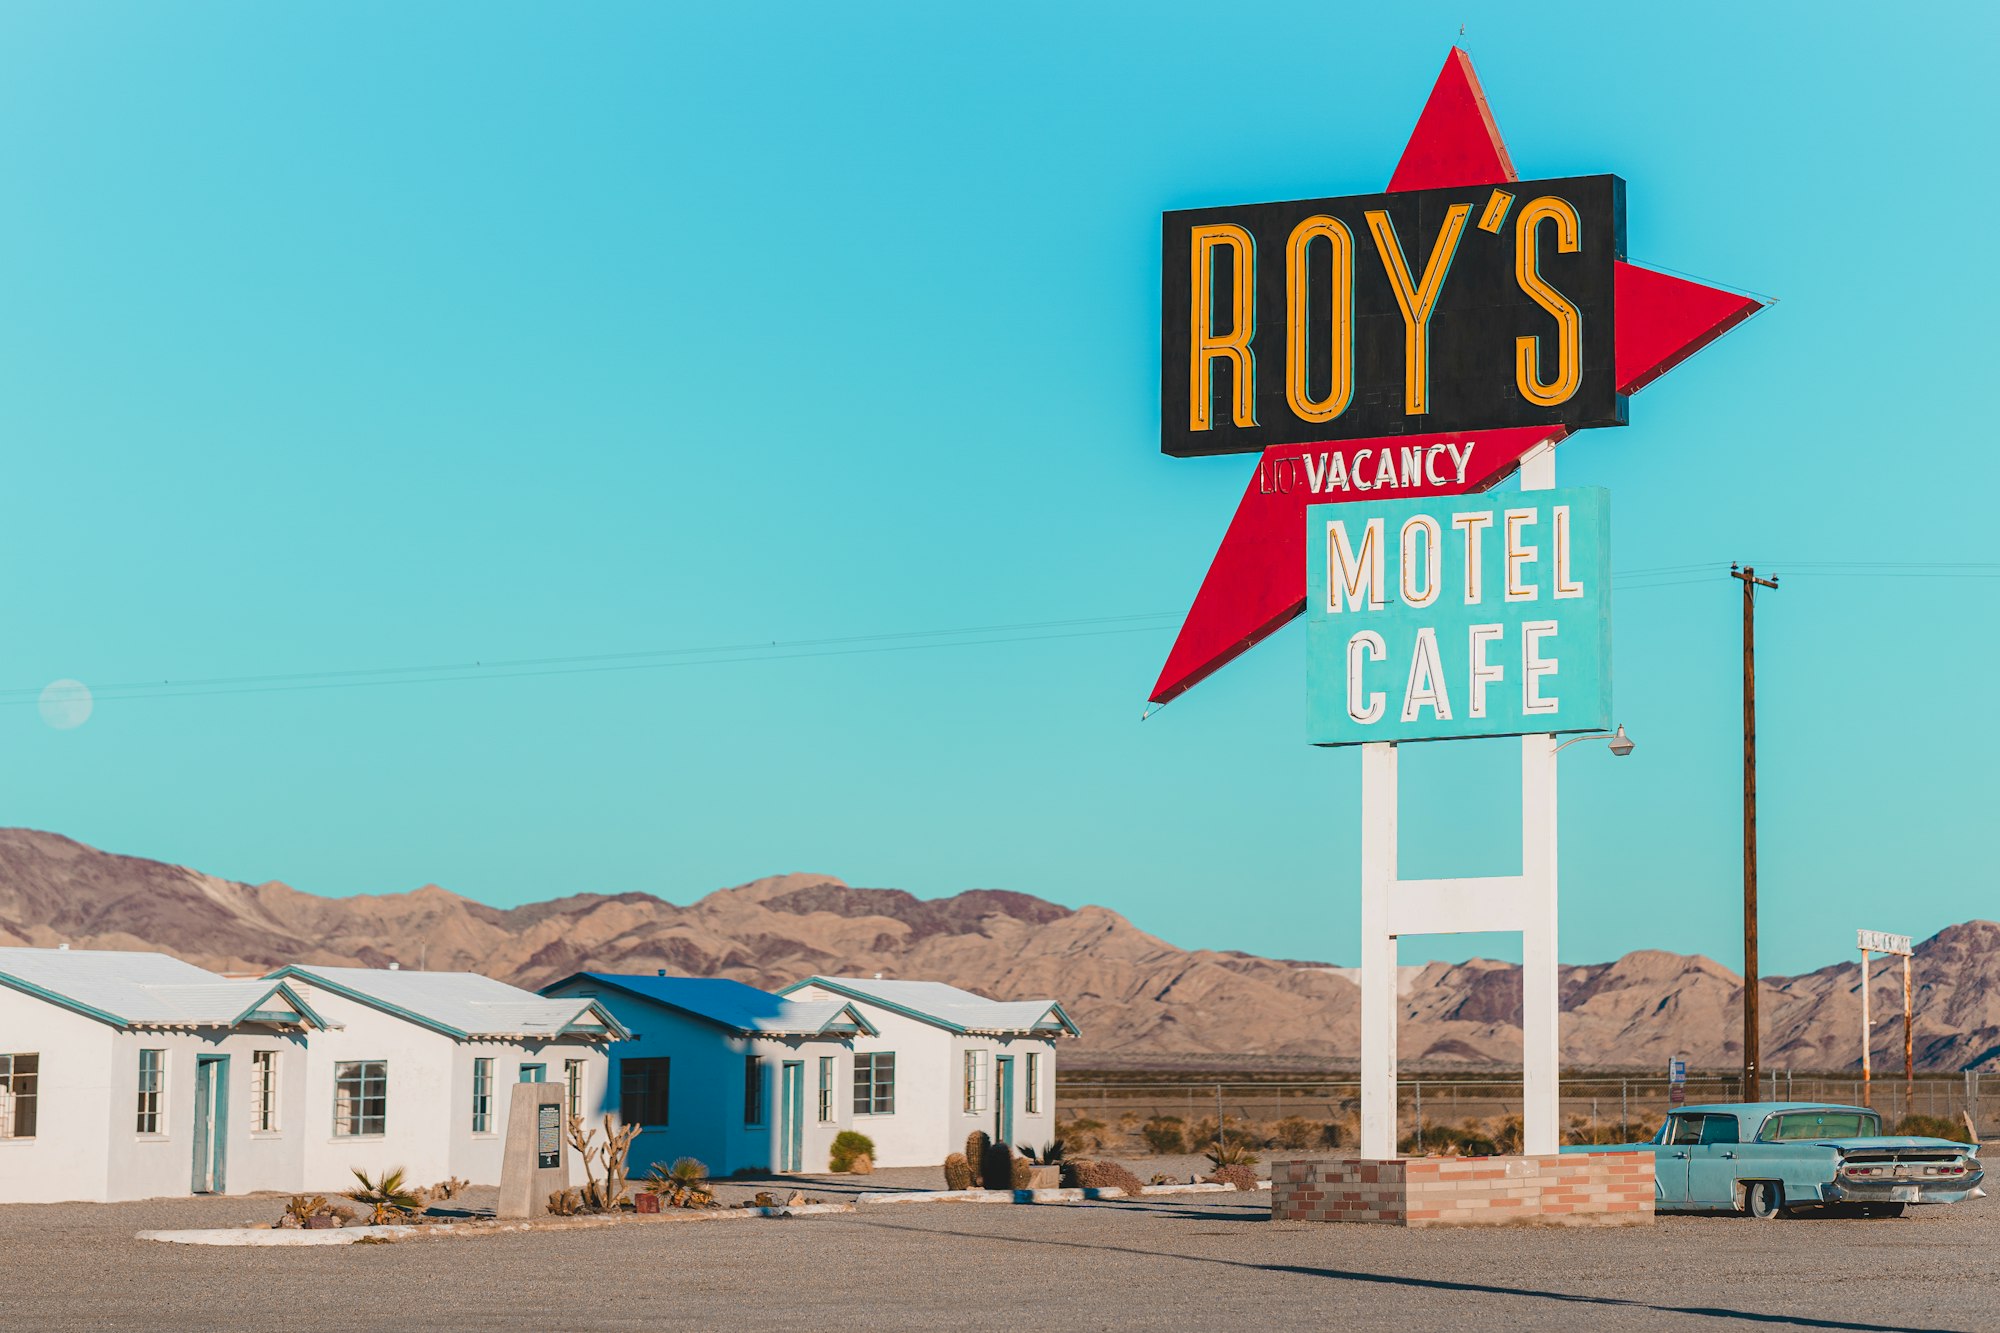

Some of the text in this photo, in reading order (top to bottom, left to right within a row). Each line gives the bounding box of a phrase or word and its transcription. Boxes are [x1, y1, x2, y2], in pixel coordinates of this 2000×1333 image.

[1190, 188, 1584, 431] ROY'S
[1302, 441, 1476, 494] VACANCY
[1326, 505, 1584, 613] MOTEL
[1346, 620, 1559, 725] CAFE
